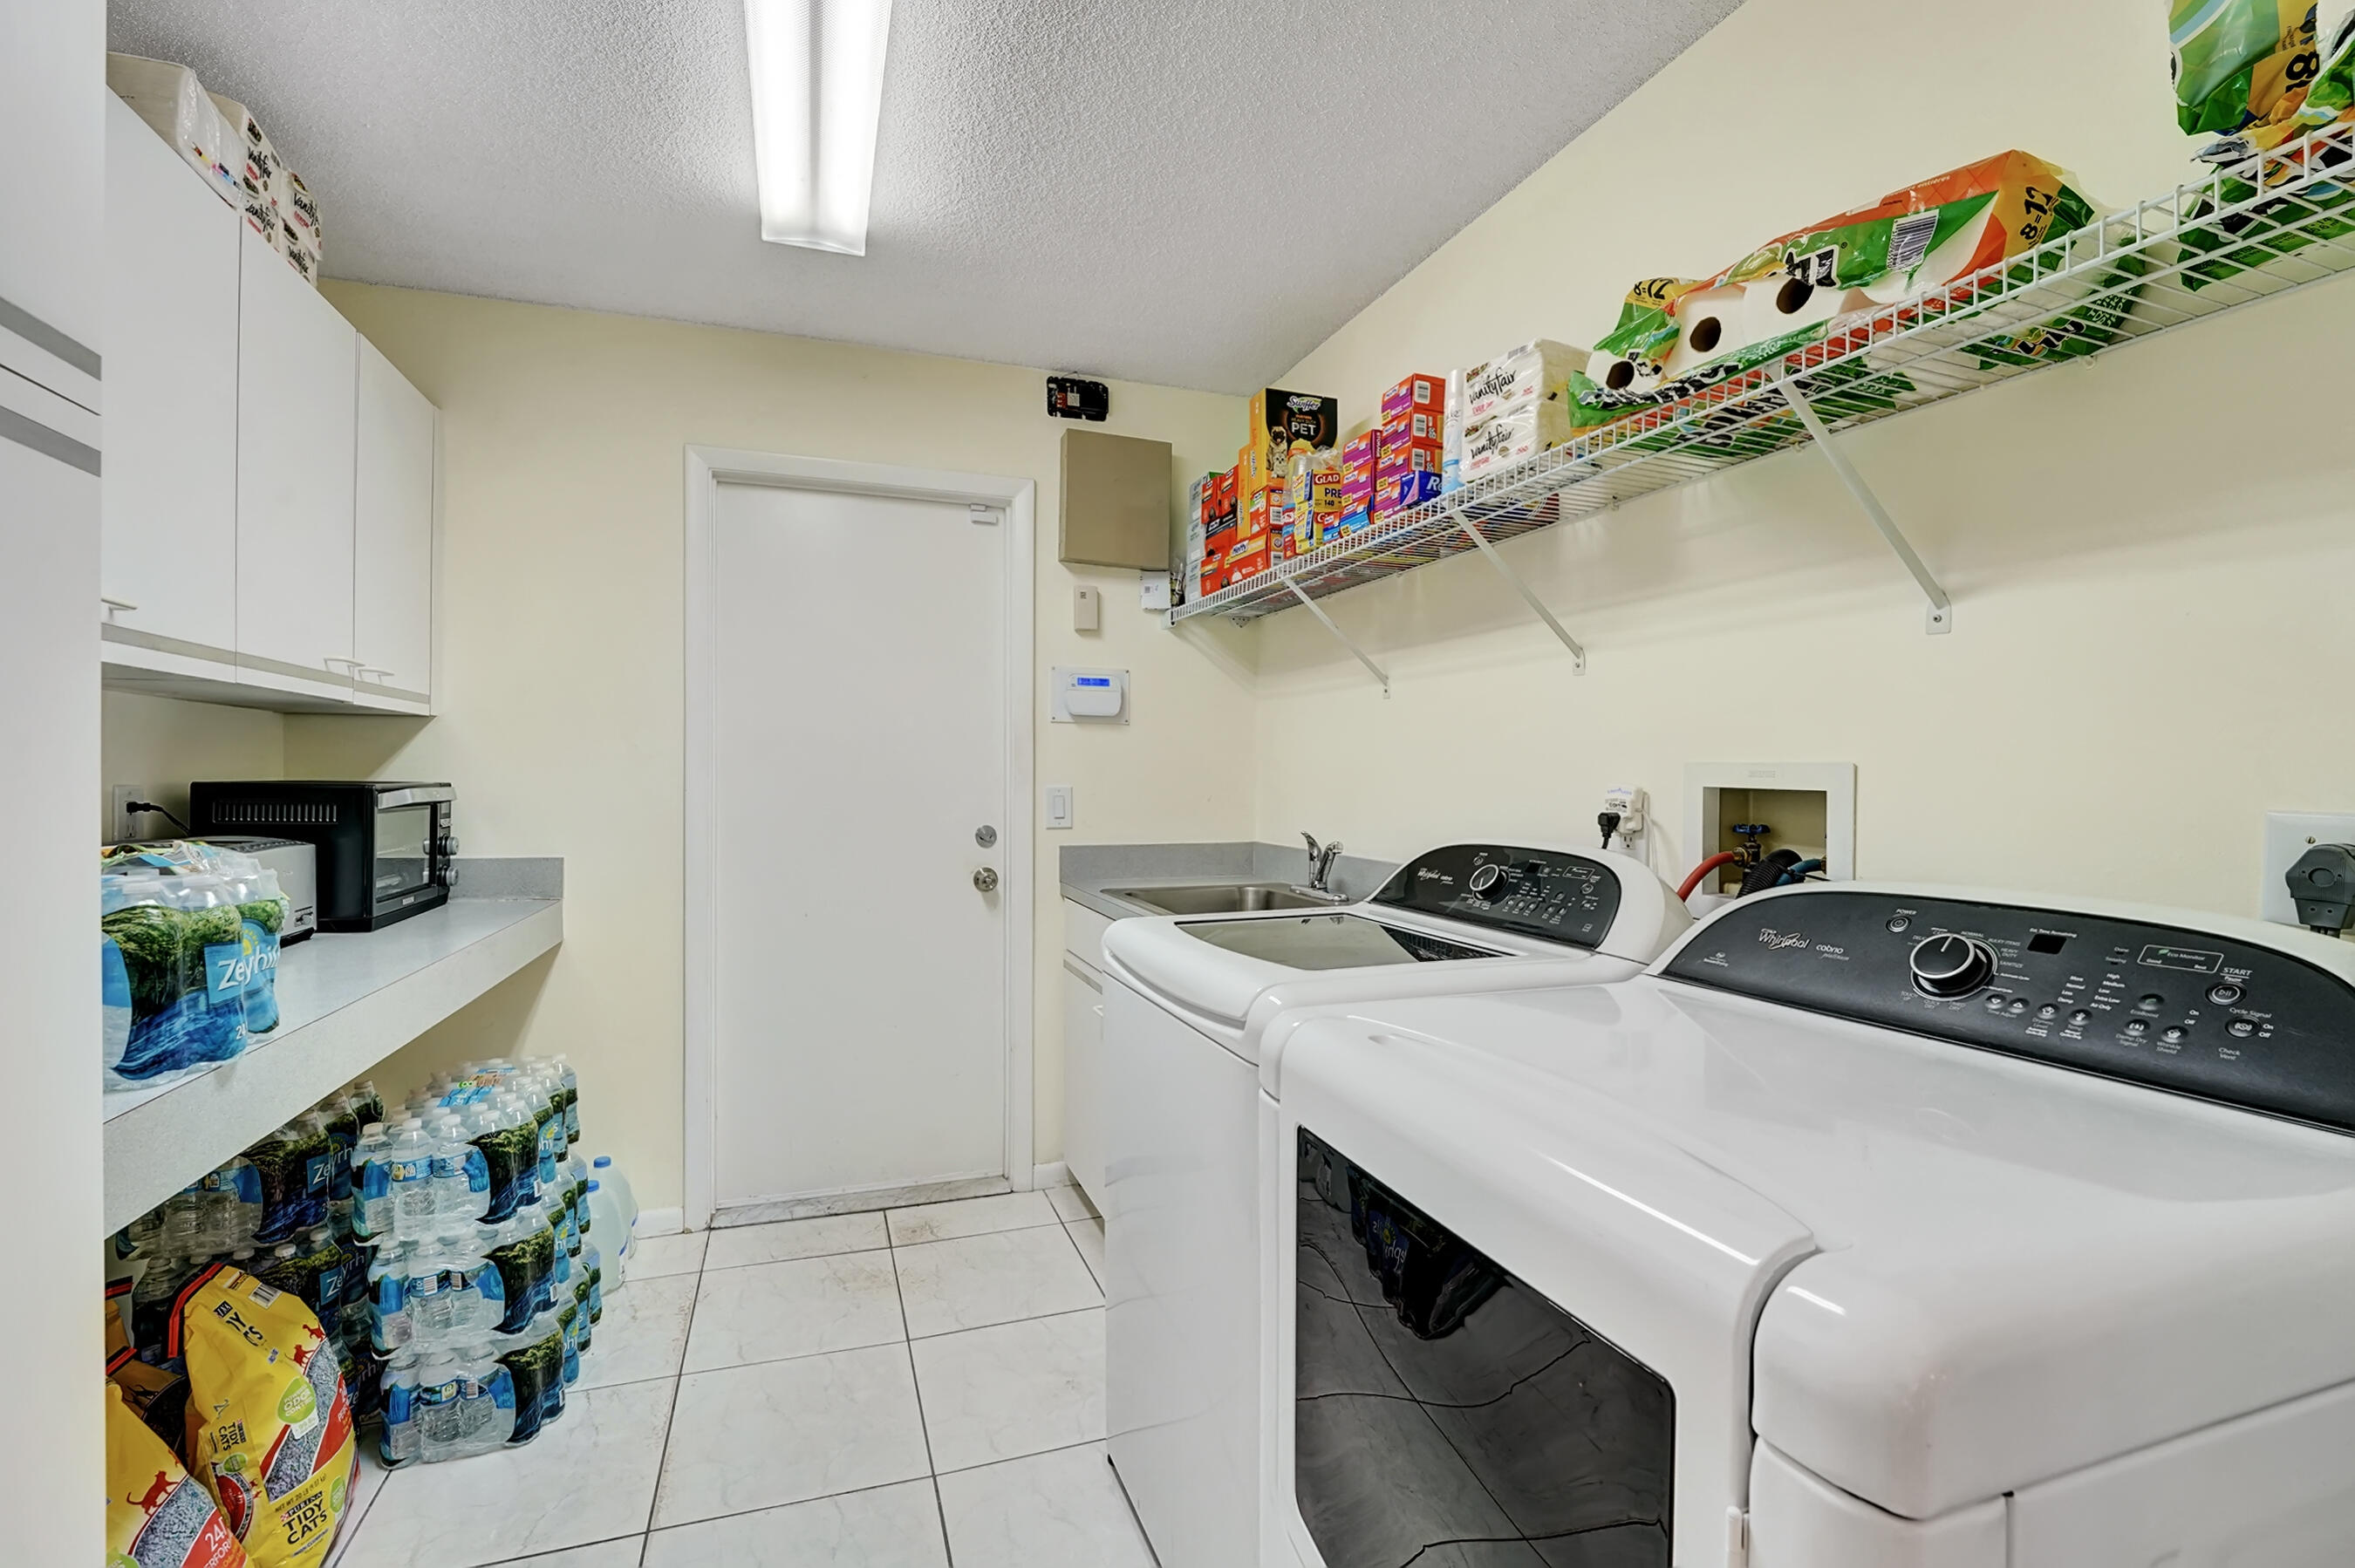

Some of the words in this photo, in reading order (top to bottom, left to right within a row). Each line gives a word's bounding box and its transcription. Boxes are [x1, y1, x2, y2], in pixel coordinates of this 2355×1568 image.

[1287, 395, 1321, 412] Swiffer
[1291, 422, 1316, 436] PET
[1314, 474, 1340, 484] GLAD
[1758, 931, 1810, 950] Whirlpool
[2223, 967, 2253, 977] START
[2229, 1006, 2249, 1016] Cycle
[2249, 1010, 2272, 1019] Signal
[218, 1426, 231, 1451] CATS
[228, 1421, 240, 1446] TIDY
[289, 1490, 323, 1516] PURINA
[283, 1498, 323, 1531] TIDY
[287, 1510, 327, 1544] CATS
